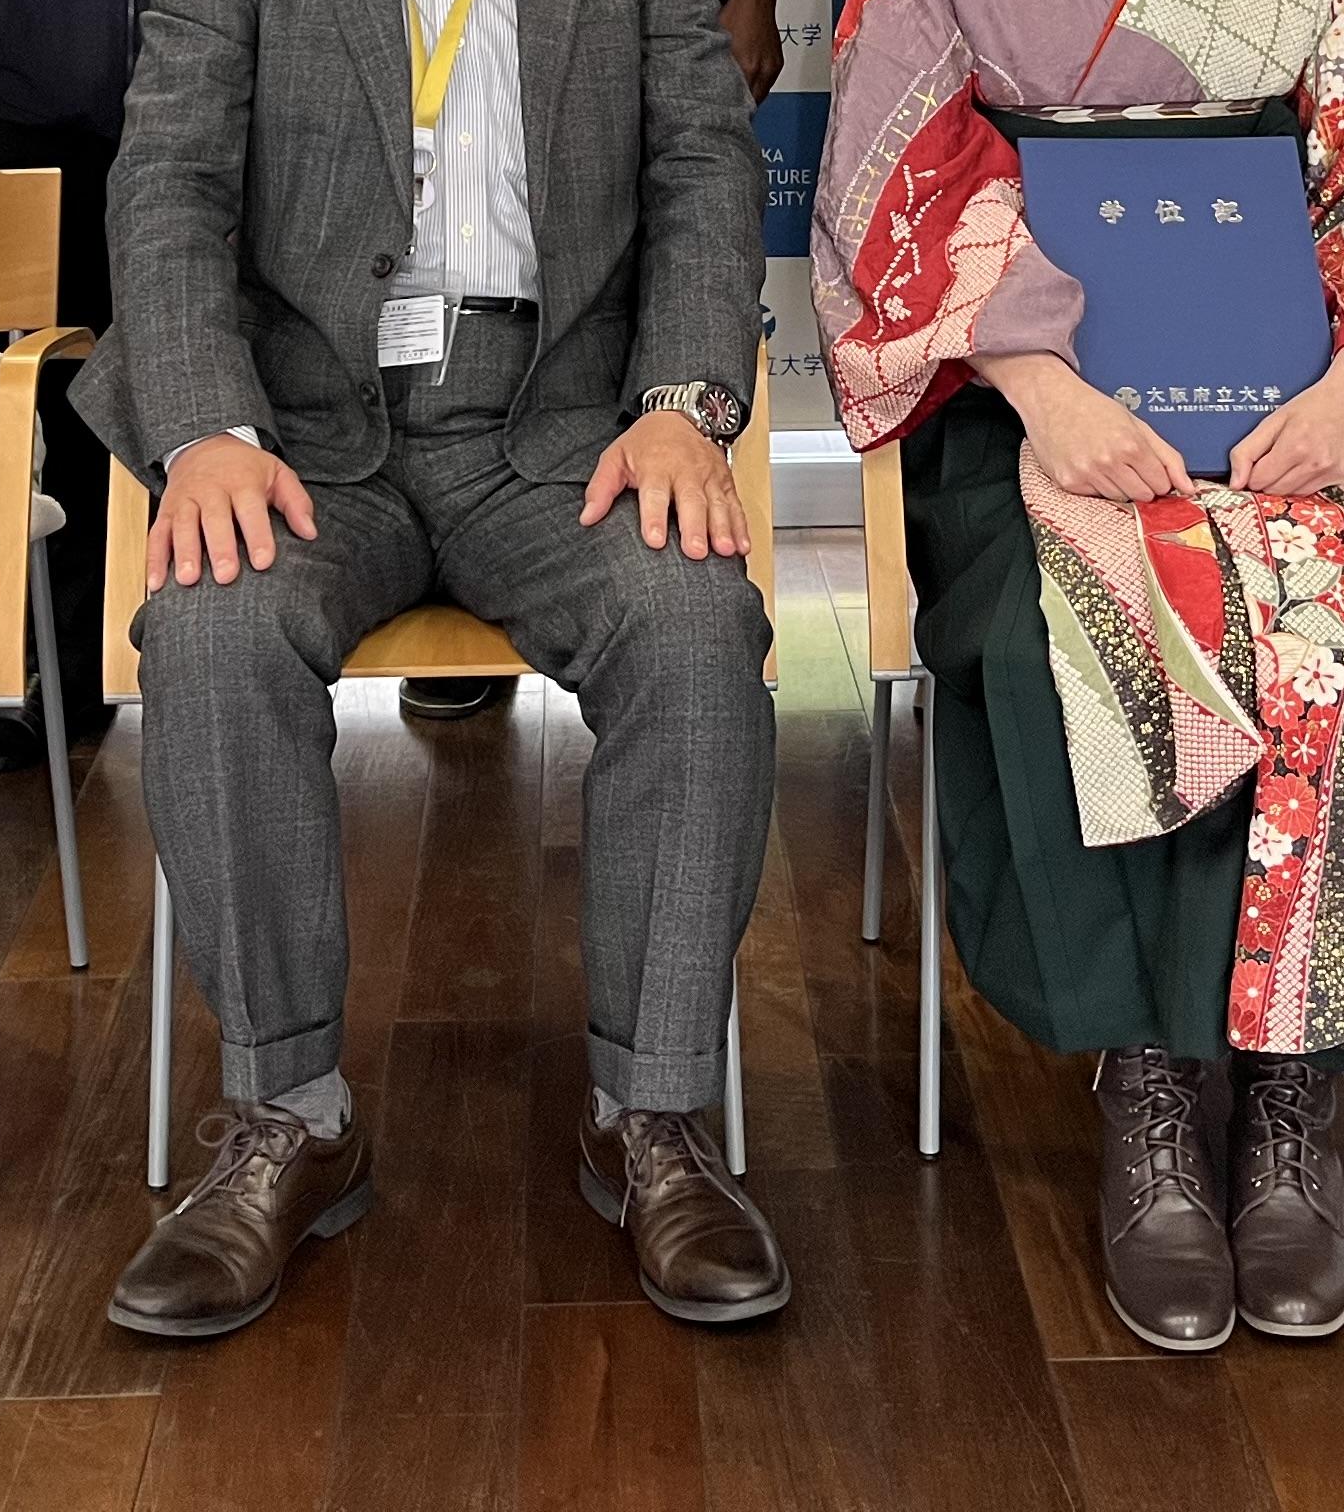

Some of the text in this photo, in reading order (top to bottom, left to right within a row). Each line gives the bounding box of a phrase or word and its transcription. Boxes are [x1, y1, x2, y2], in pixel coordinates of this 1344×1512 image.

[1146, 386, 1281, 404] 大阪府立大学
